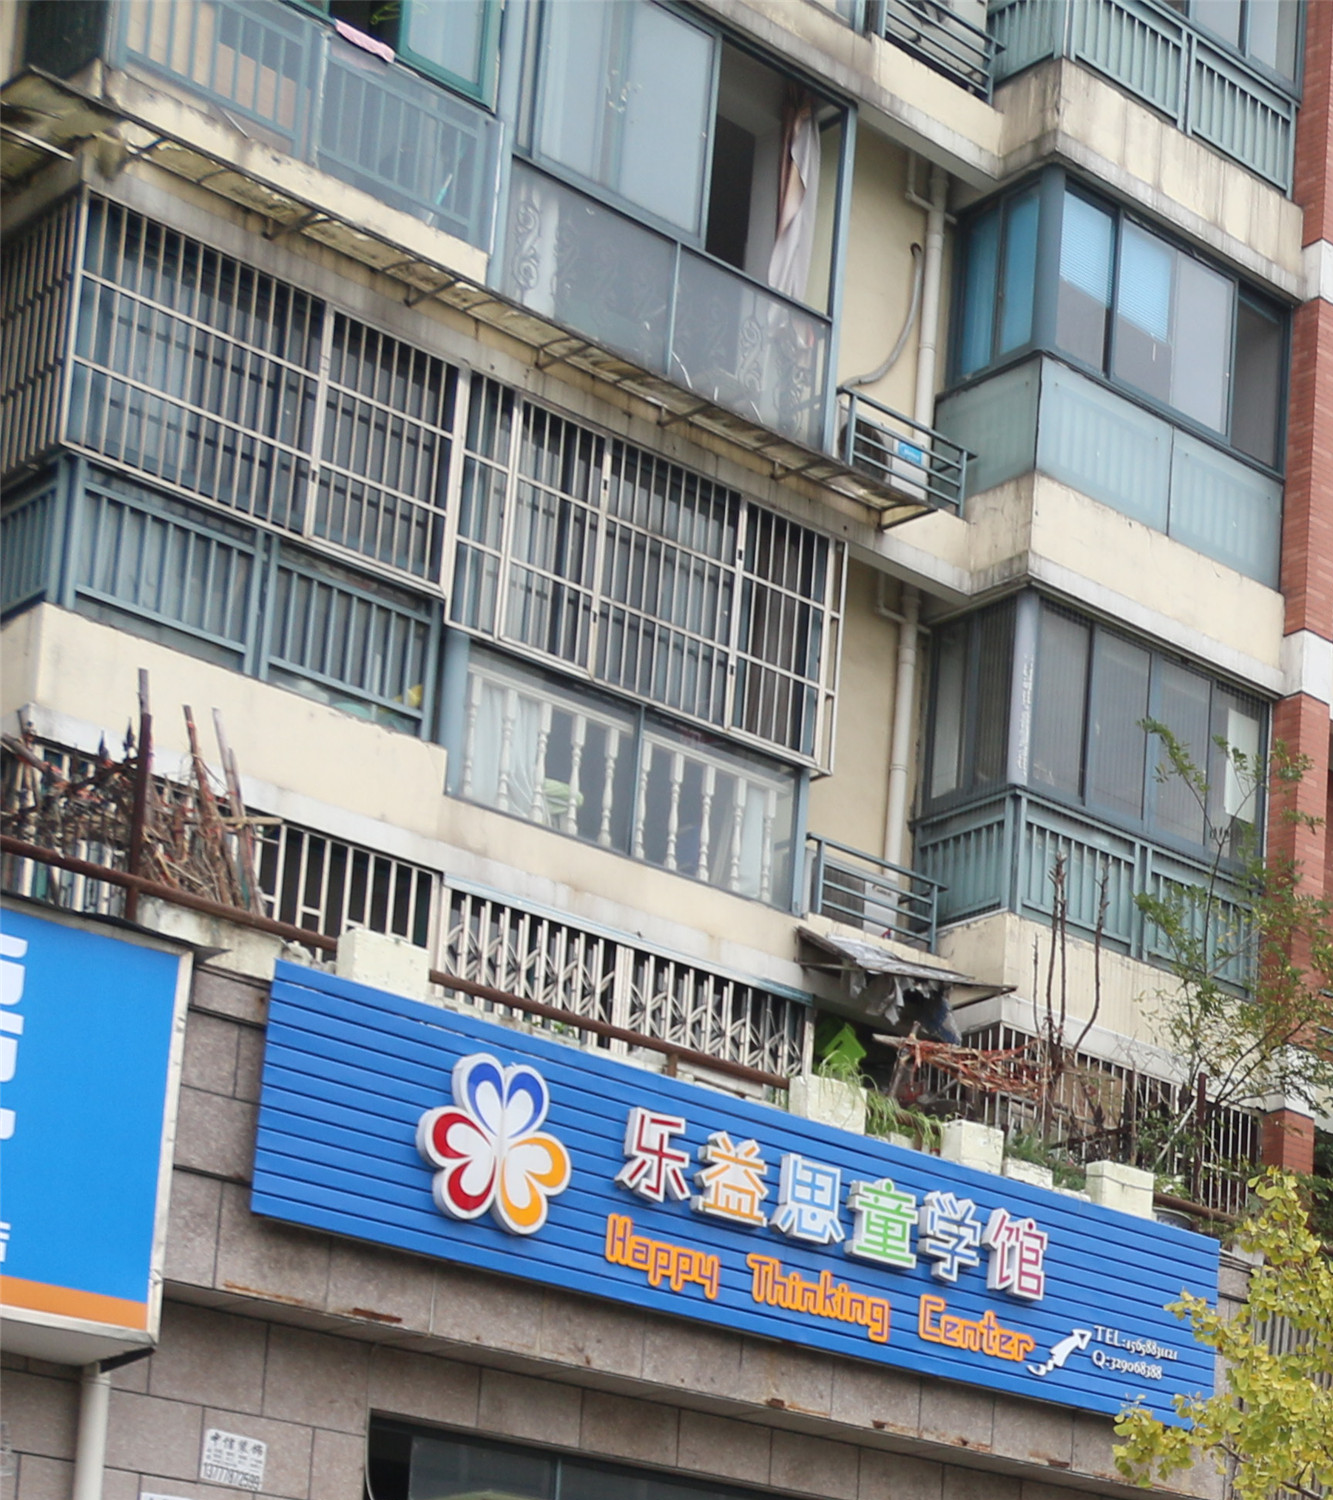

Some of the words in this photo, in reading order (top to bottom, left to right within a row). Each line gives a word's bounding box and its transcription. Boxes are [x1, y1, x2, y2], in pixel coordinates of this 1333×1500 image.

[605, 1213, 719, 1300] Happy
[747, 1253, 890, 1343] Thinking
[918, 1294, 1035, 1362] Center
[614, 1106, 1048, 1300] 乐益思童学馆
